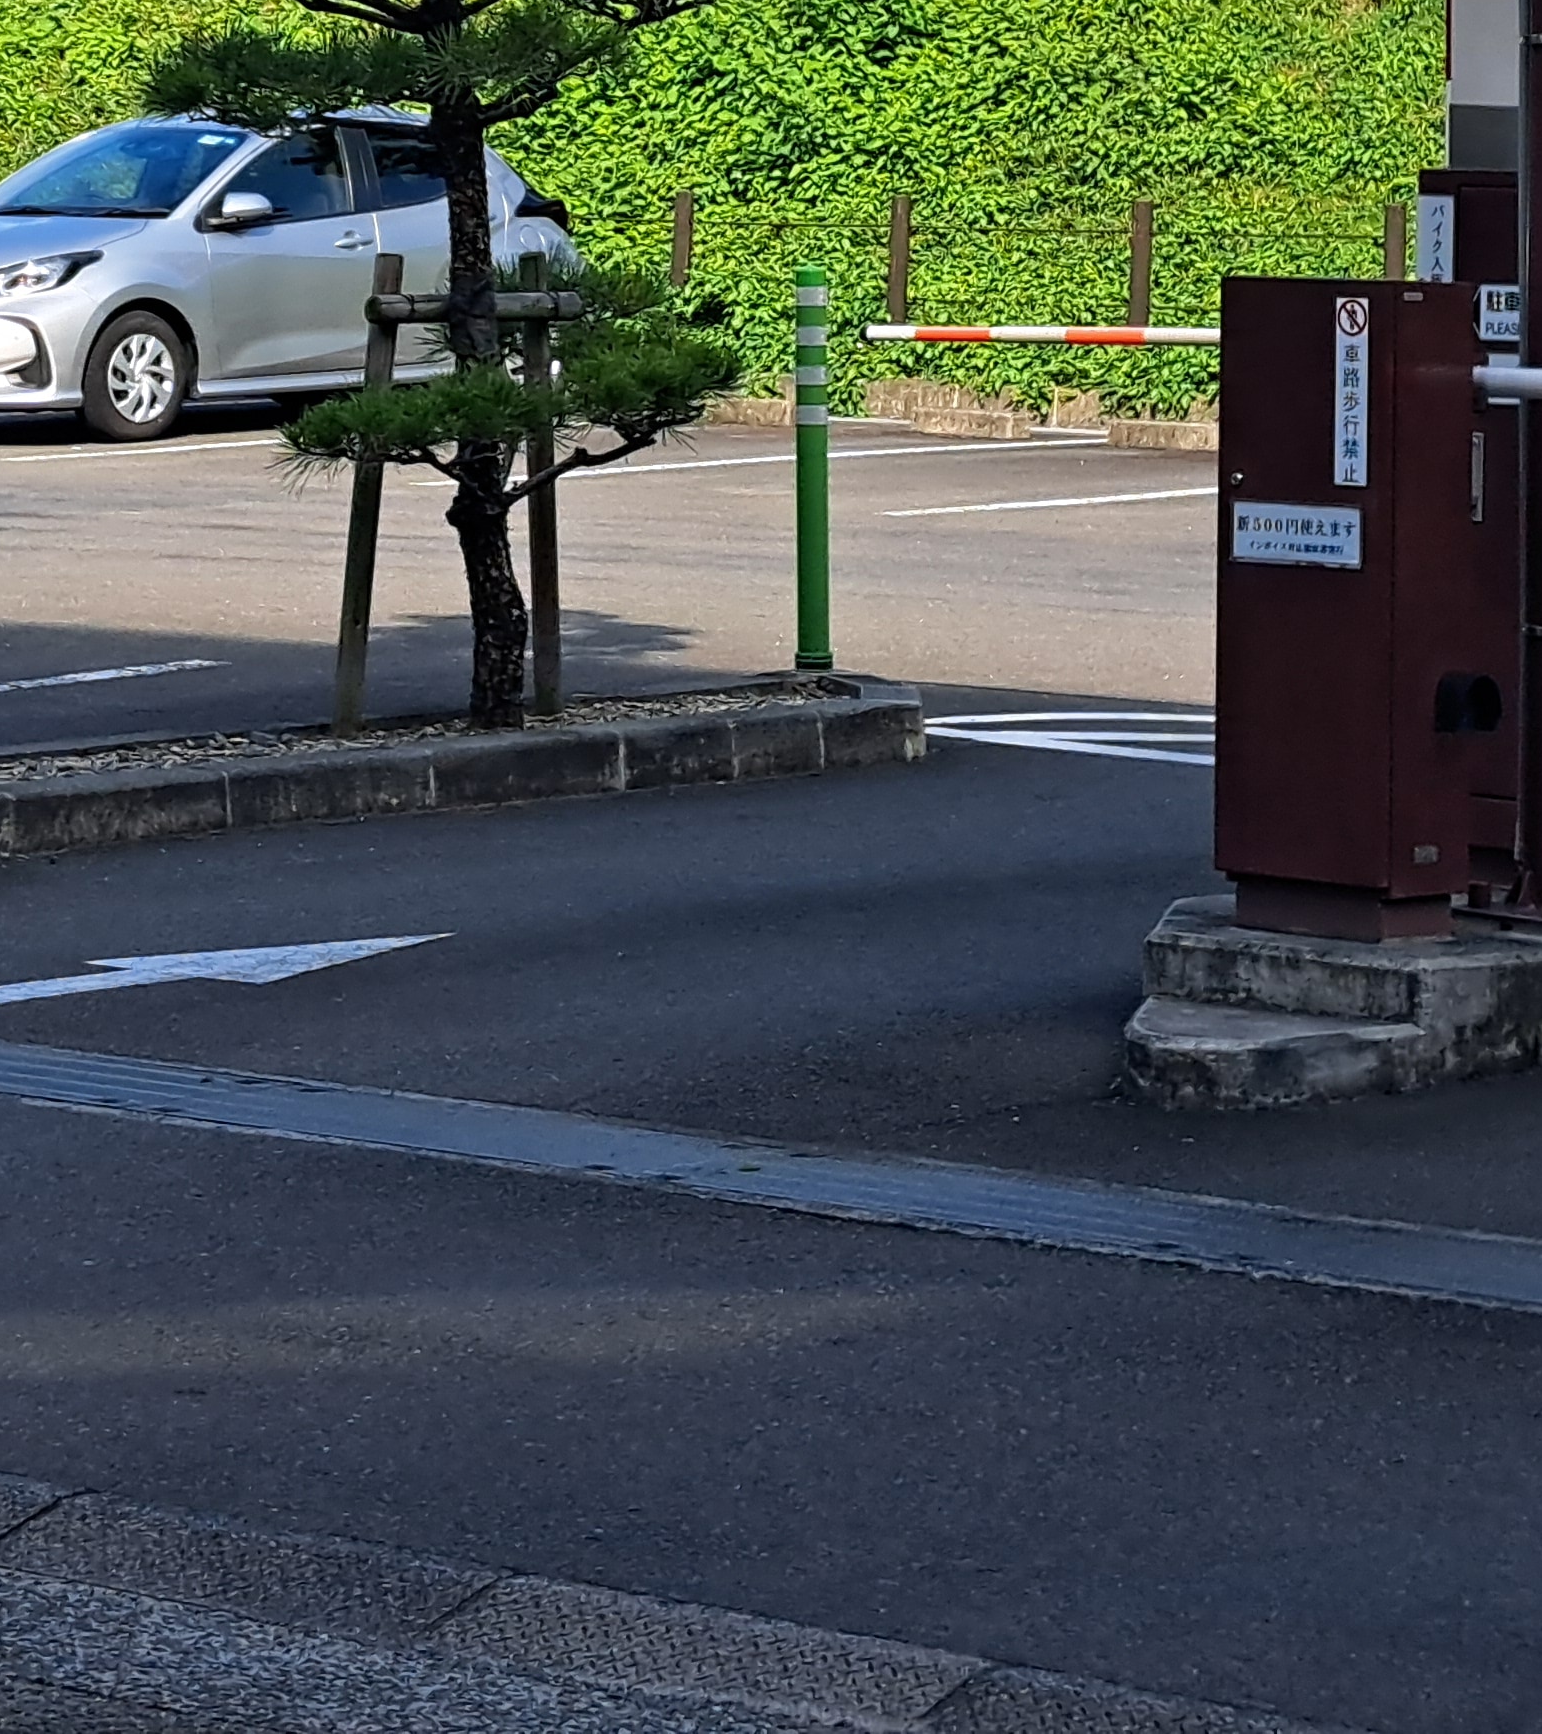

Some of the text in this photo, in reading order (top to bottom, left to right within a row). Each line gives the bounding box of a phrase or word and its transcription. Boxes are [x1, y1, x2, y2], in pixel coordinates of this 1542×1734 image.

[1485, 322, 1520, 336] PLEAS
[1342, 343, 1361, 484] 車路歩行禁止
[1236, 514, 1357, 539] 新500円使えます
